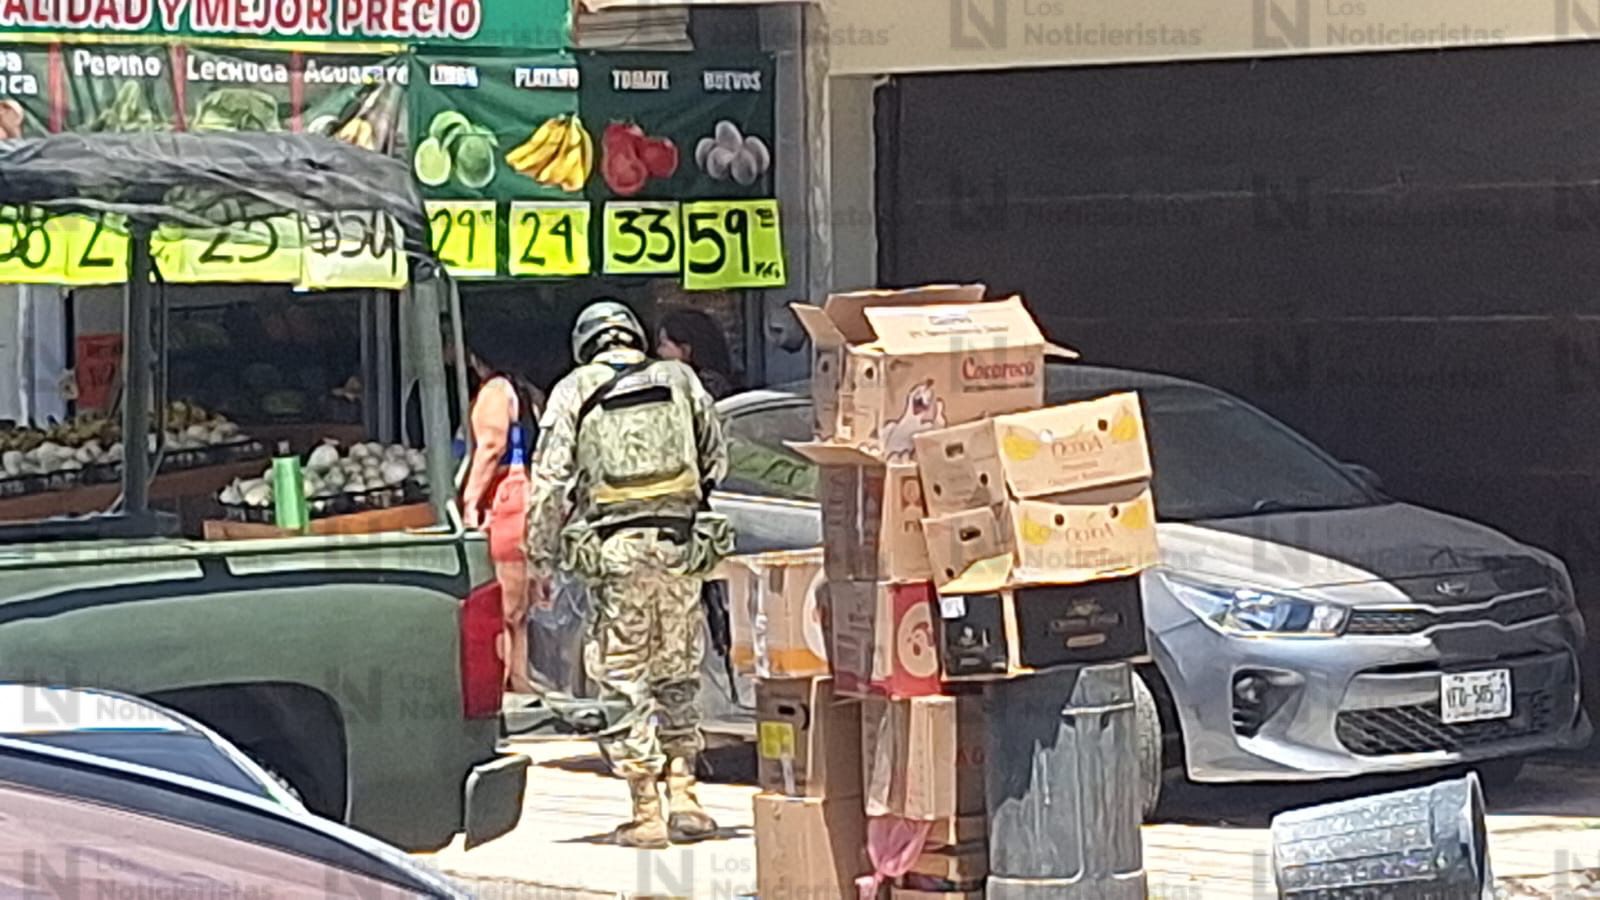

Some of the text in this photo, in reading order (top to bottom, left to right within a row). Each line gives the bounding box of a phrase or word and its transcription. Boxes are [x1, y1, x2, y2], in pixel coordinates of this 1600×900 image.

[161, 0, 186, 25] Y
[195, 0, 328, 29] MEJOR
[343, 0, 477, 33] PRECIO
[611, 69, 670, 90] TOMATE
[519, 210, 575, 266] 24
[612, 208, 677, 264] 33
[687, 208, 751, 275] 59
